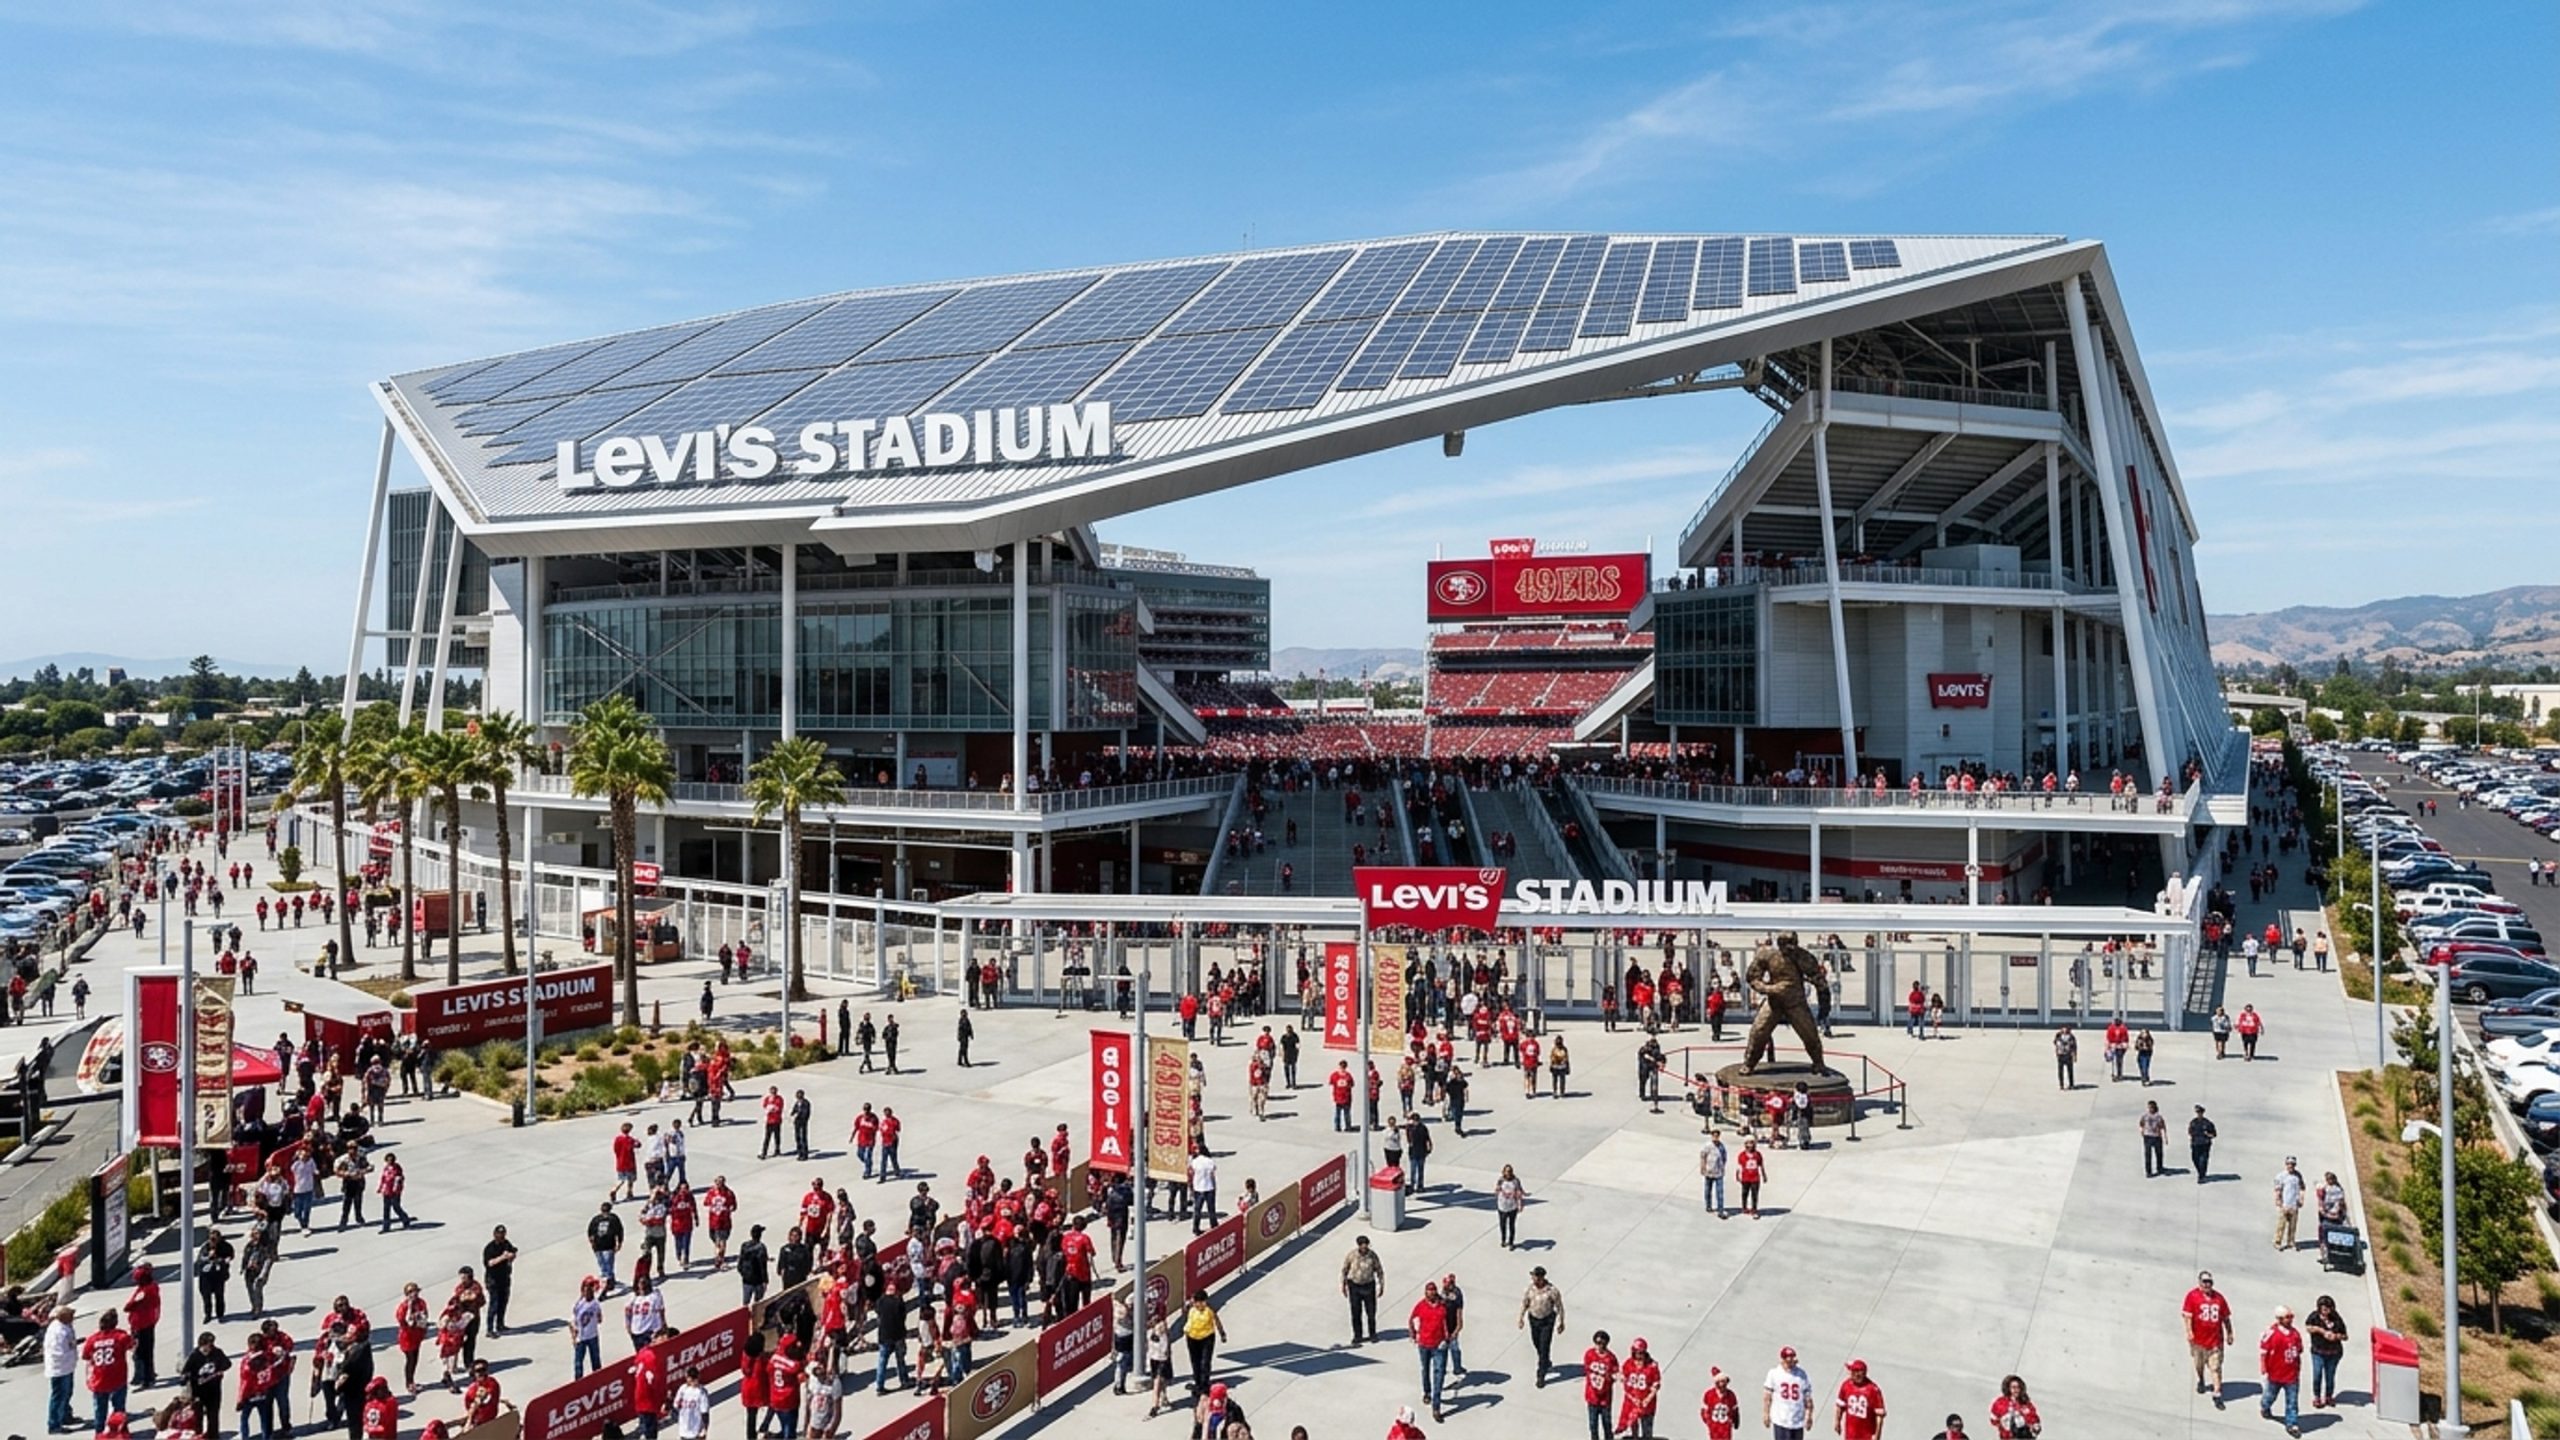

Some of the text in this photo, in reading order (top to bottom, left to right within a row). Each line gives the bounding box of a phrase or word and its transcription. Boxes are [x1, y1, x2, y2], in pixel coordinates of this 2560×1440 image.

[799, 401, 1112, 475] STADIUM
[1514, 565, 1621, 603] 49ERS
[1515, 879, 1728, 915] STADIUM
